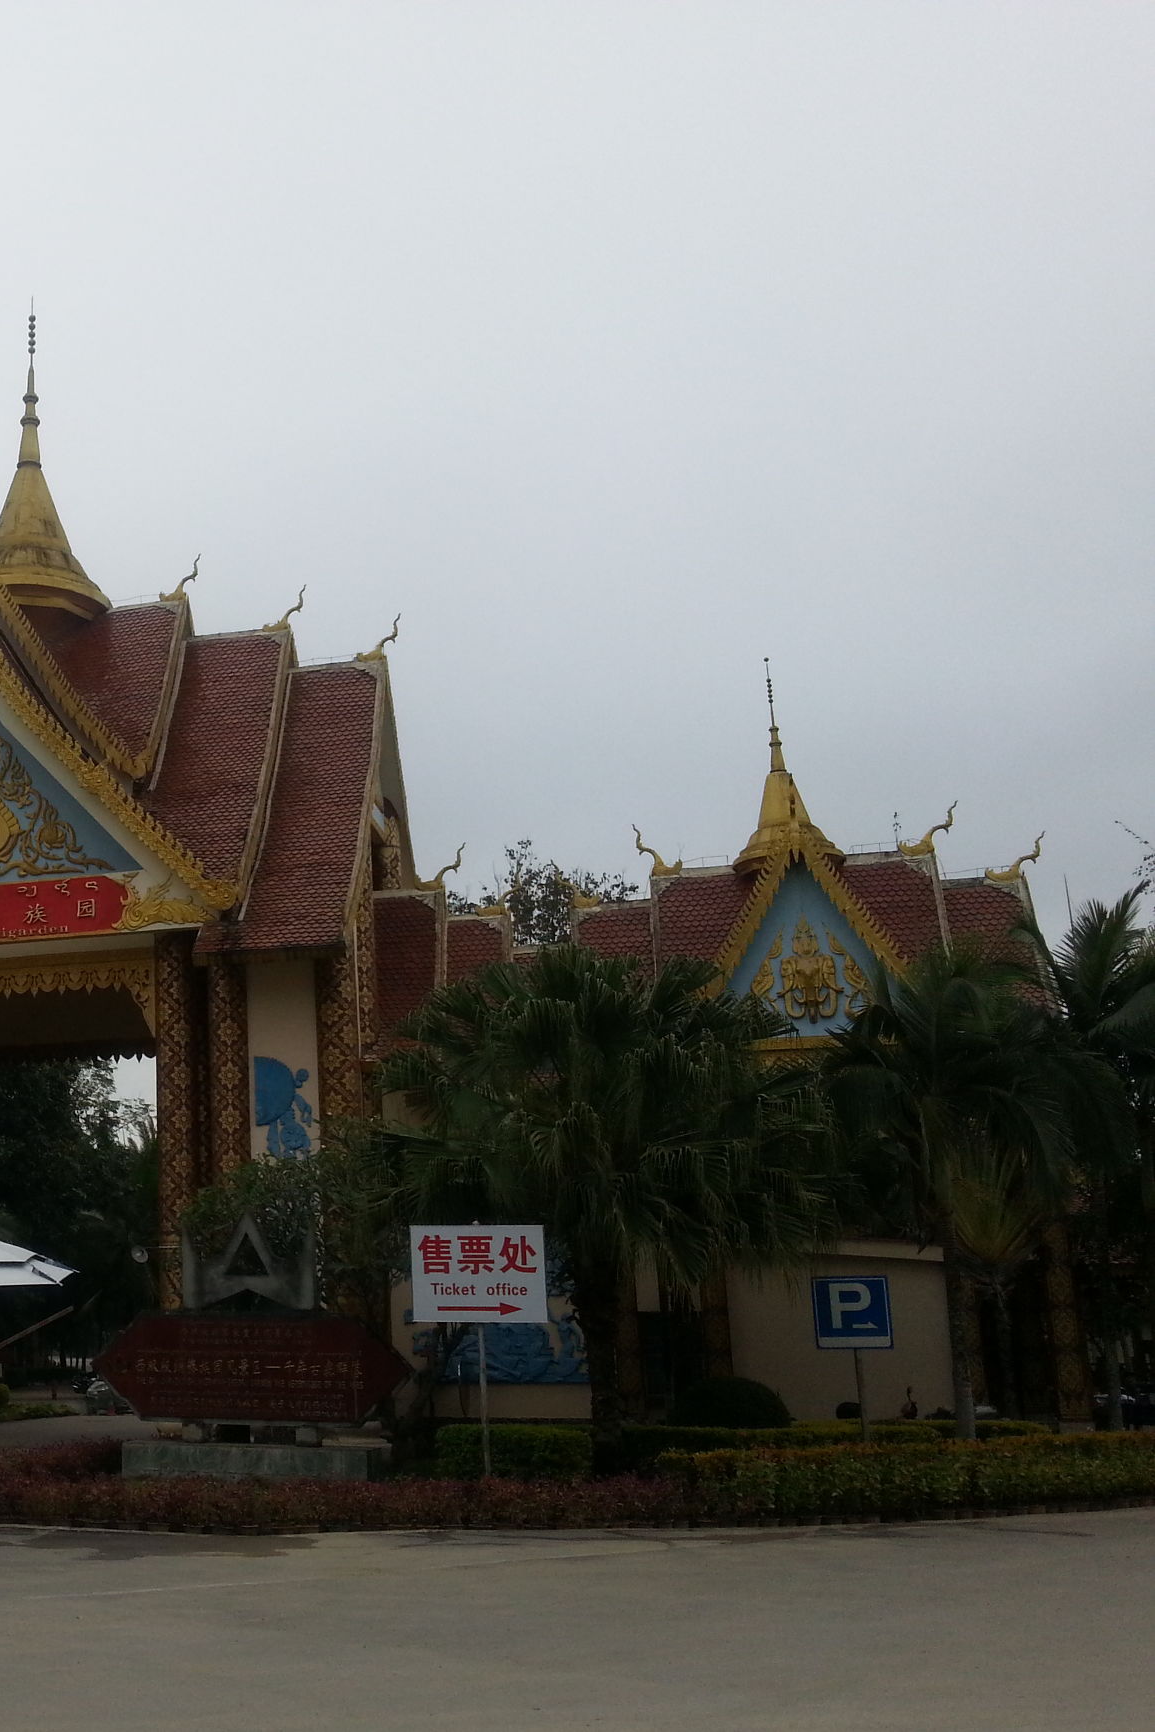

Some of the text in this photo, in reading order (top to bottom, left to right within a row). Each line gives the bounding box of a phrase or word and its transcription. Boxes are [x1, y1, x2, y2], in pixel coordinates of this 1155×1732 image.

[418, 1235, 537, 1275] 售票处
[431, 1282, 528, 1296] Ticket office
[829, 1283, 872, 1328] P
